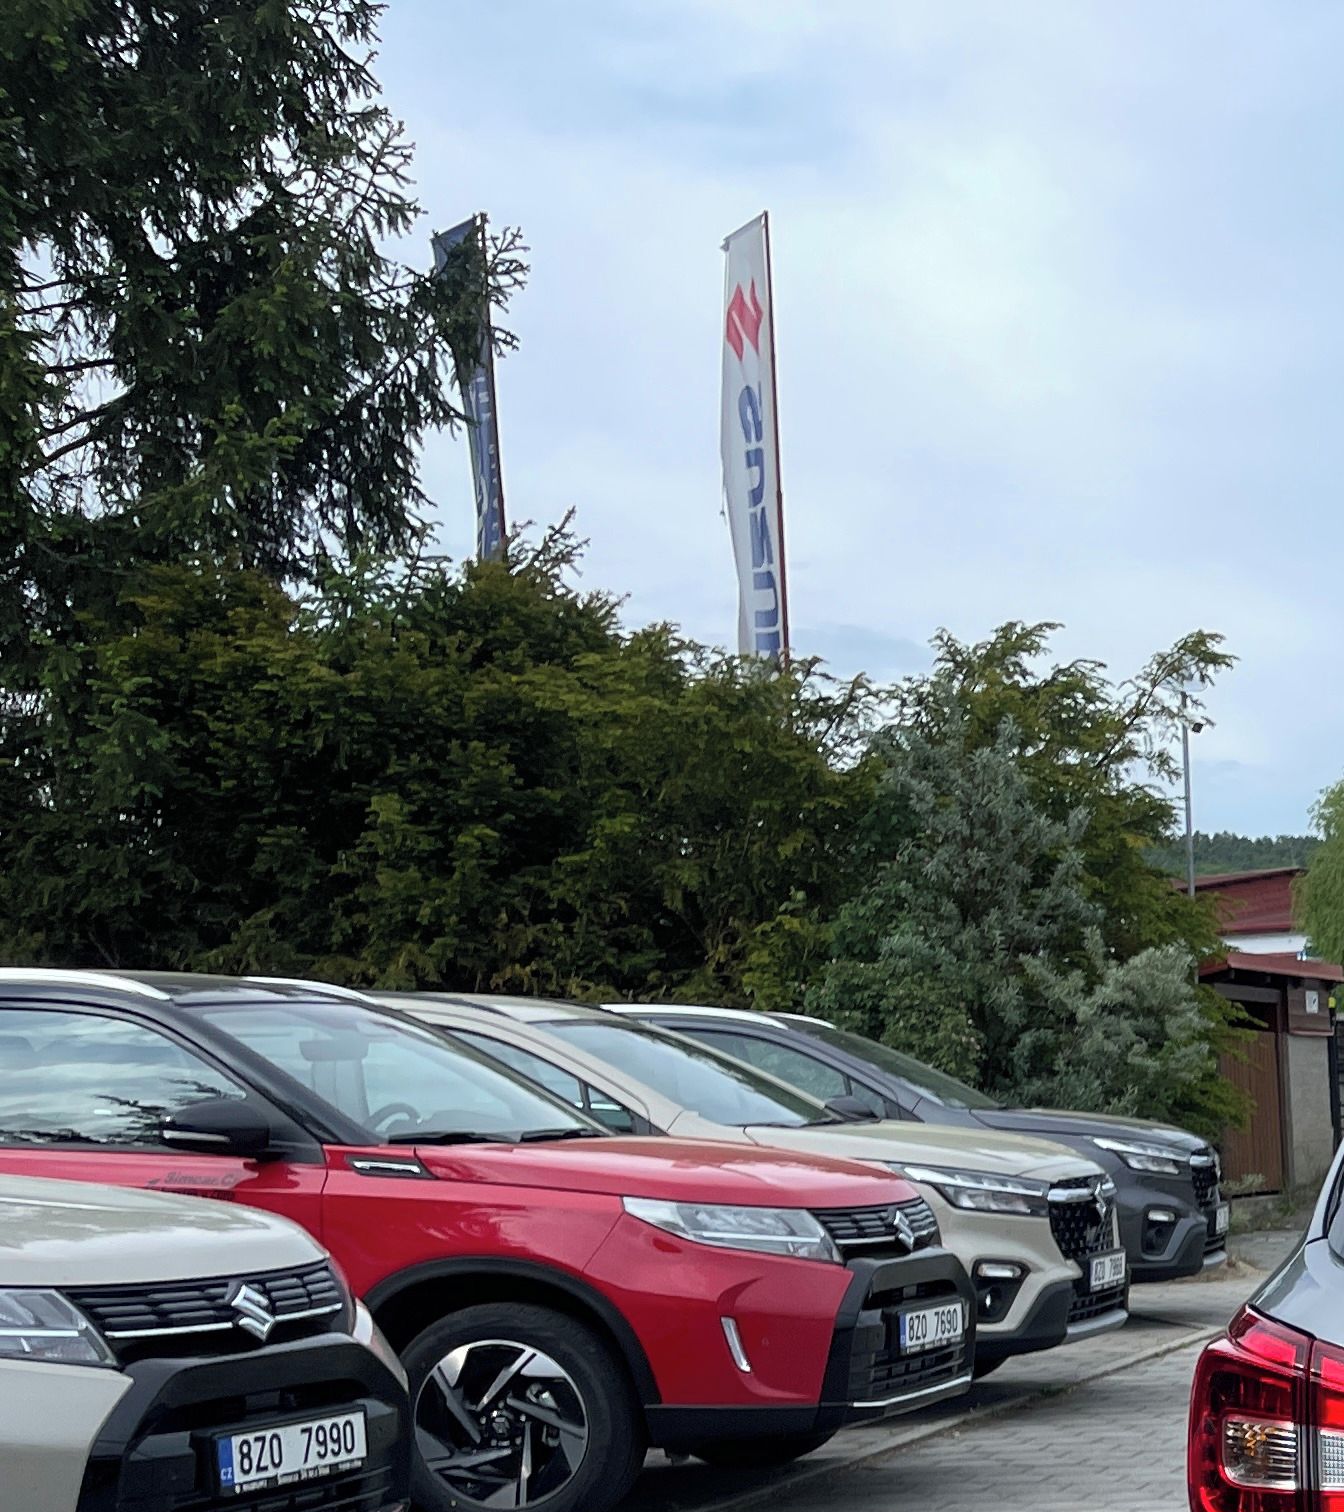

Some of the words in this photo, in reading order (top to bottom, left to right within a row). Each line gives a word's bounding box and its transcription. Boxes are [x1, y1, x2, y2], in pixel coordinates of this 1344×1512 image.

[934, 1307, 958, 1338] 7690
[300, 1419, 356, 1465] 7990
[220, 1466, 233, 1481] CZ
